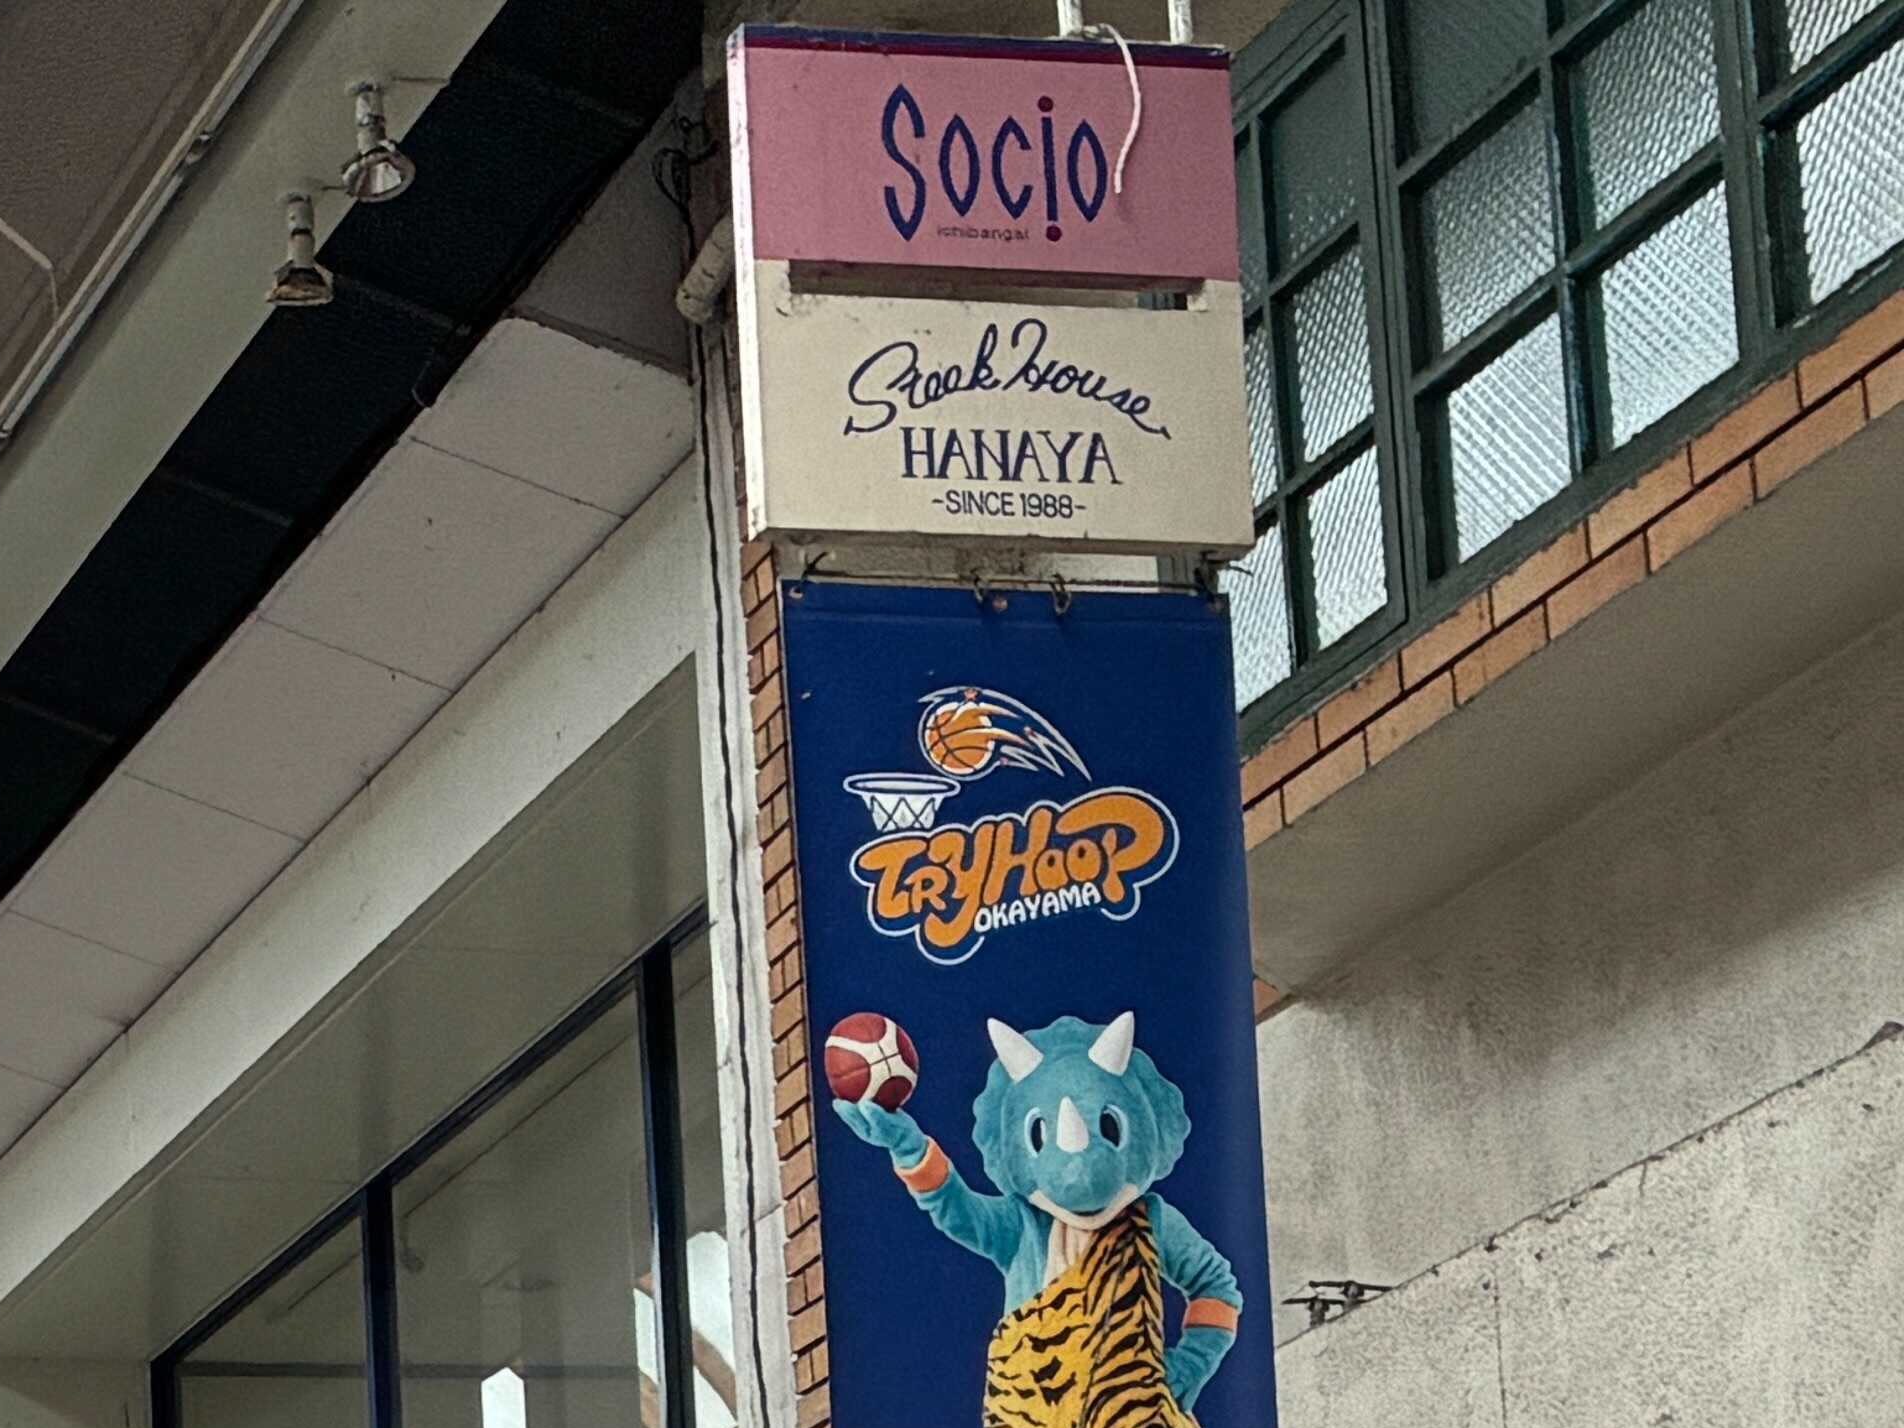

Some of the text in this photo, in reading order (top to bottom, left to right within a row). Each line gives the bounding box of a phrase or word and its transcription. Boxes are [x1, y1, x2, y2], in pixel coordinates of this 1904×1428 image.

[881, 83, 1108, 242] Socio
[900, 426, 1123, 485] HANAYA
[973, 882, 1102, 934] OKAYAMA
